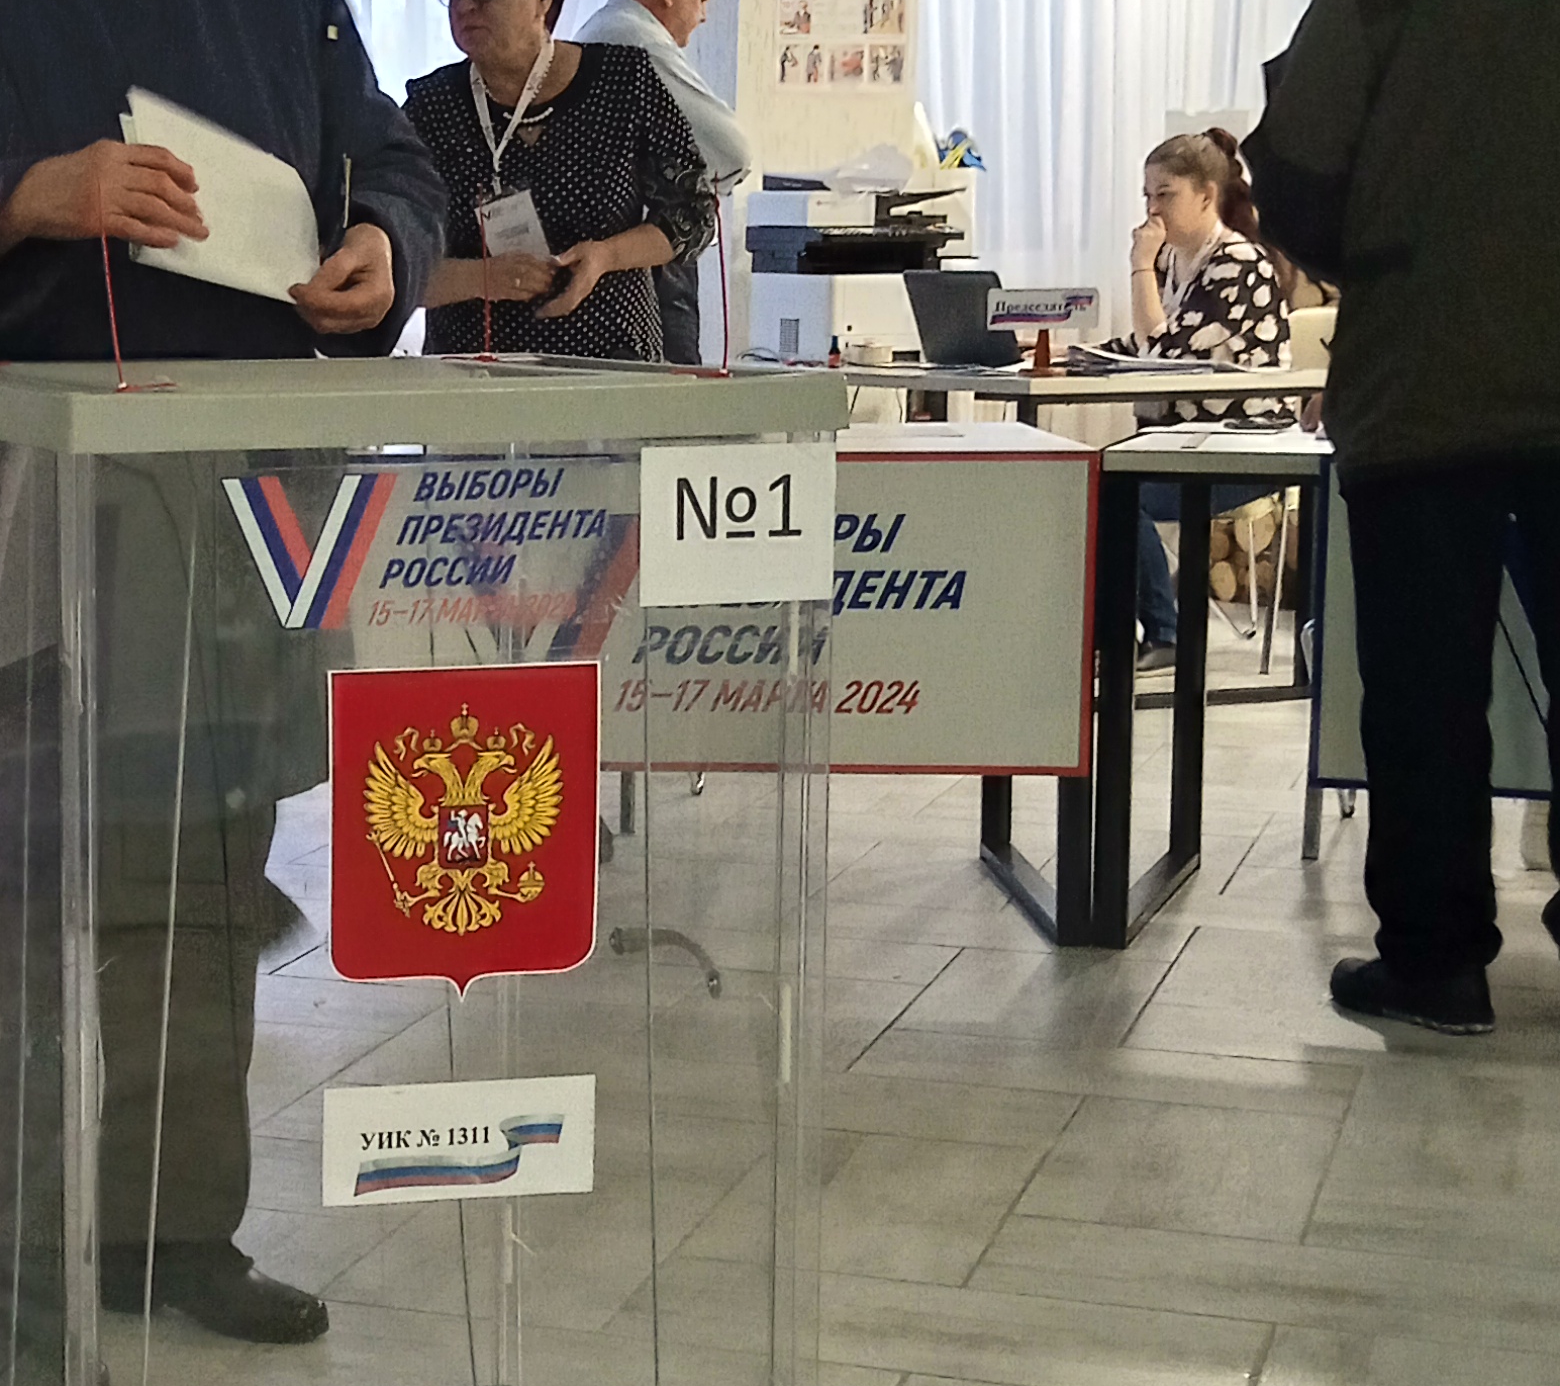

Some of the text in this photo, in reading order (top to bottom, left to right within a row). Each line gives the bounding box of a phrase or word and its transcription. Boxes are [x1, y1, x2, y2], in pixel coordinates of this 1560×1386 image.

[412, 467, 565, 503] ВЫБОРЫ
[675, 473, 802, 541] №1
[396, 509, 607, 546] ПРЕЗИДЕНТА
[378, 554, 518, 590] РОССИИ
[630, 623, 829, 665] РОССИИ
[834, 679, 922, 714] 2024
[360, 1125, 490, 1151] УИК № 1311
